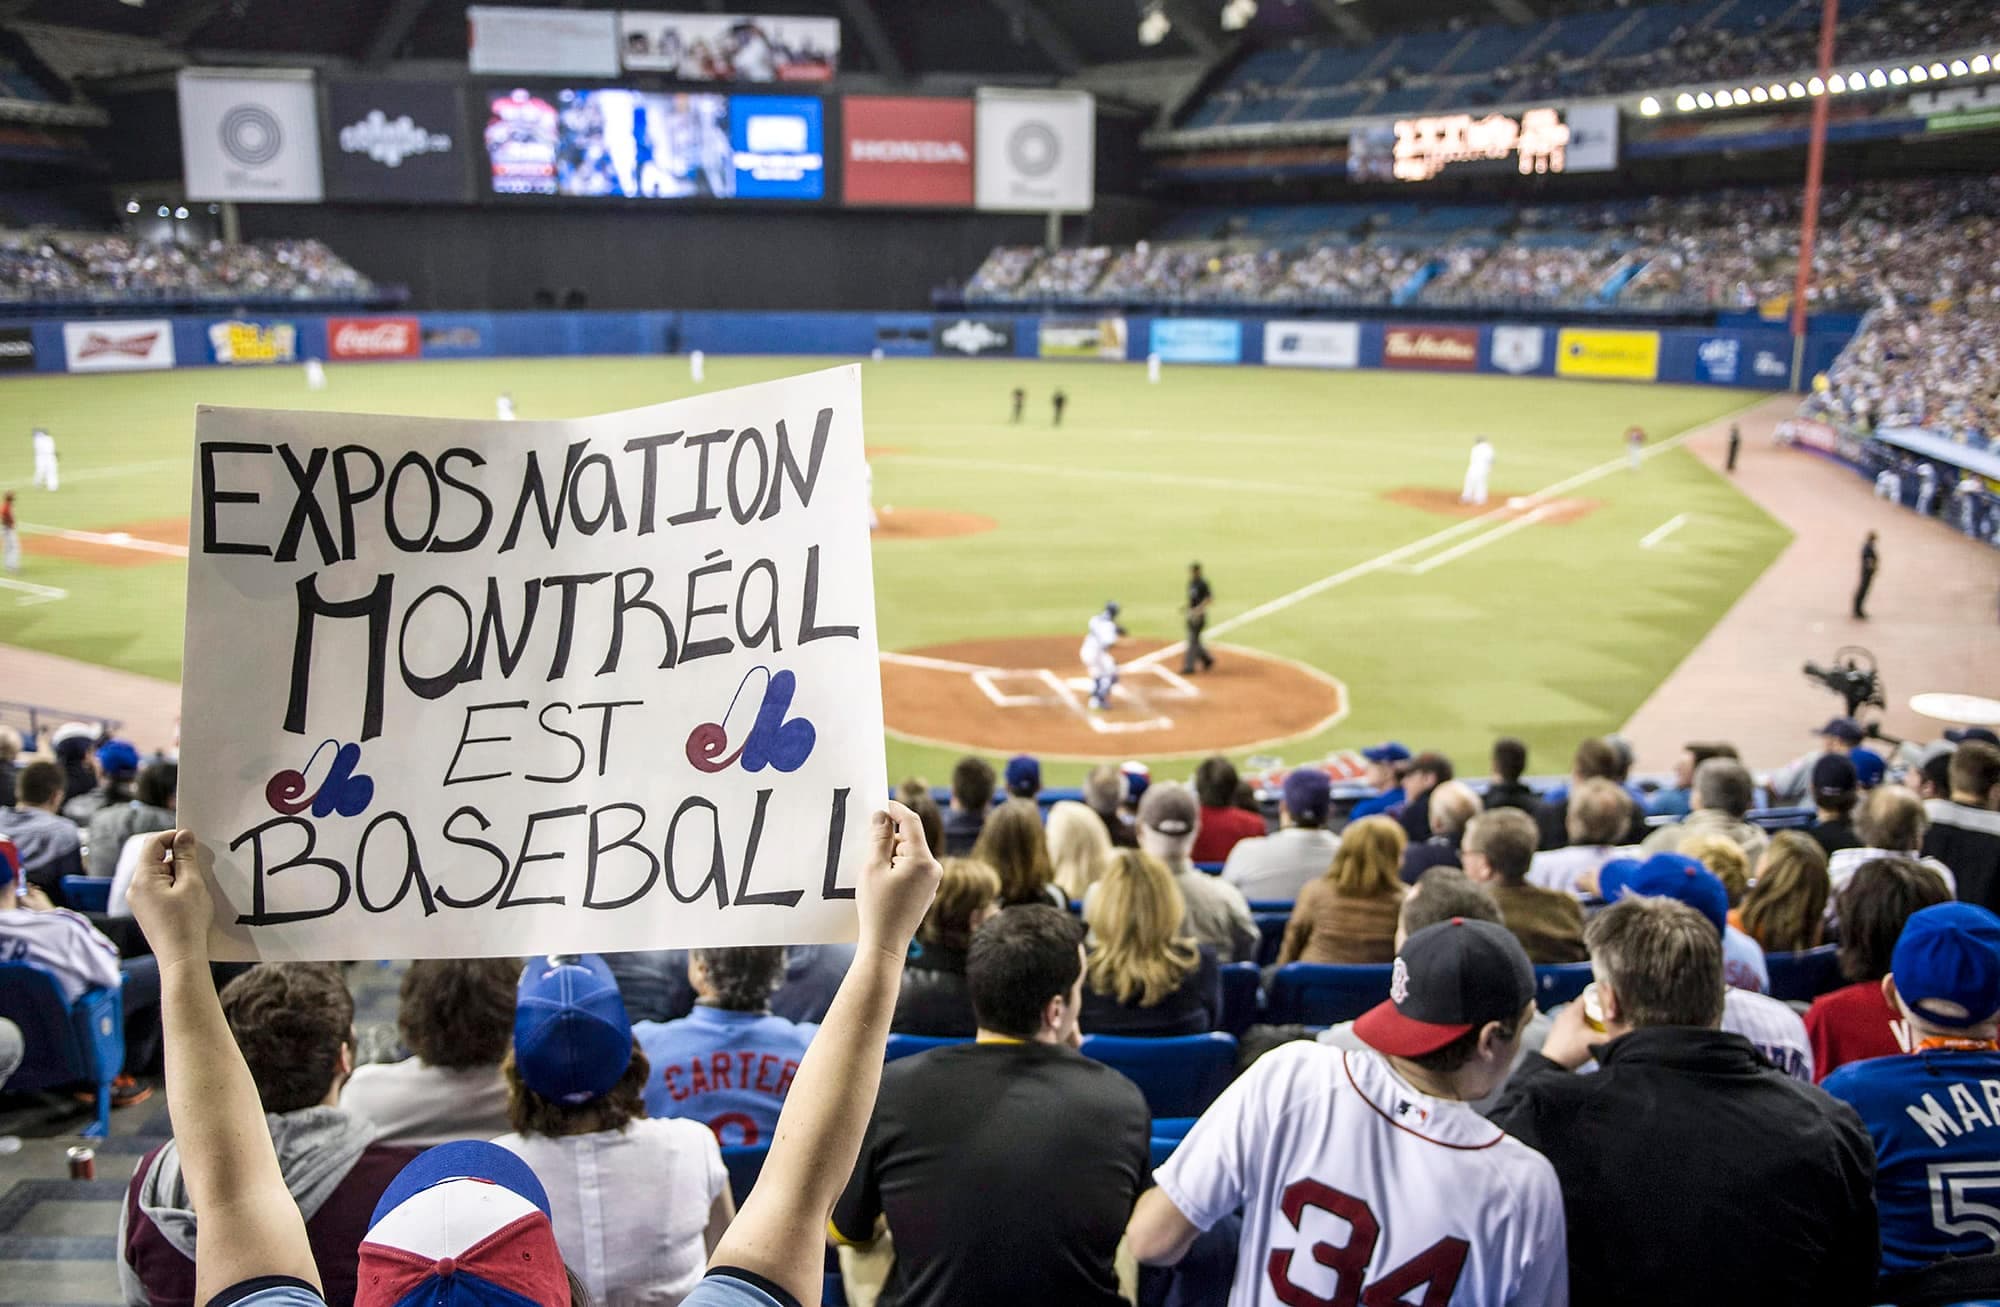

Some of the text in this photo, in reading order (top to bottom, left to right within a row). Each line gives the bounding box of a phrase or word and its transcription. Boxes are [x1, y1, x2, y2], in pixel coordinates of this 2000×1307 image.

[851, 139, 969, 163] HONDA
[200, 442, 493, 566] EXPOS
[443, 700, 643, 786] EST
